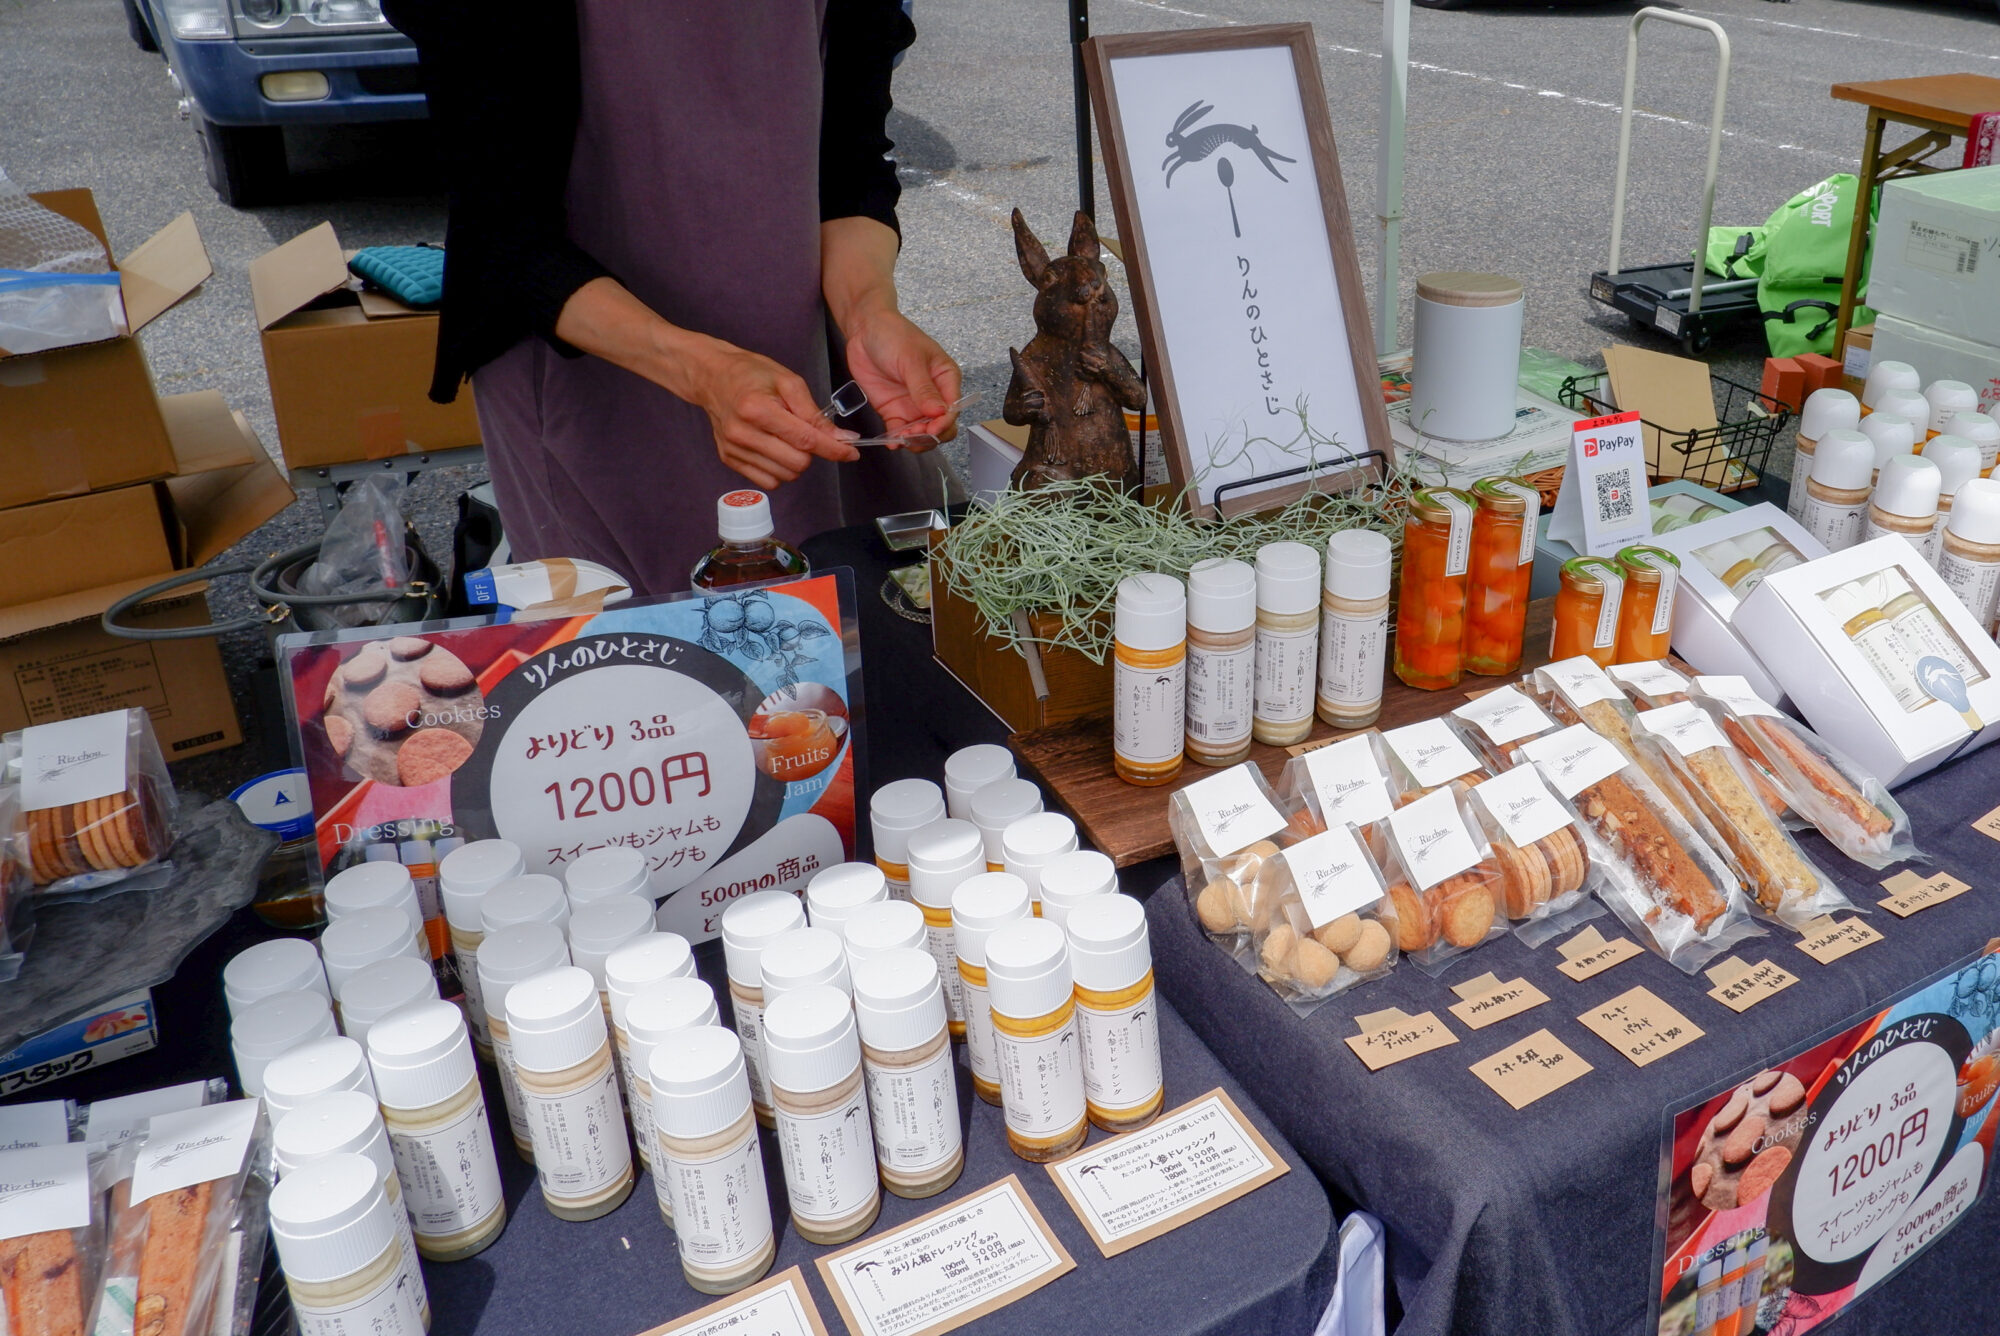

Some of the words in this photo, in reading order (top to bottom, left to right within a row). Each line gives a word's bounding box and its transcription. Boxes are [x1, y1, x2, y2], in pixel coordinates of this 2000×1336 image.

[1236, 255, 1281, 415] りんのひとさじ
[1599, 435, 1635, 453] PayPay
[475, 584, 490, 602] OFF
[522, 637, 685, 689] りんのひとさじ
[405, 703, 502, 730] Cookies
[526, 727, 615, 760] よりどり
[630, 713, 675, 742] 3品
[770, 744, 831, 775] Fruits
[544, 751, 712, 822] 1200円
[783, 774, 824, 801] Jam
[333, 815, 455, 847] Dressing
[547, 814, 721, 866] スイーツもジャムも
[700, 854, 820, 908] 500円の商品
[1107, 1030, 1122, 1095] 人参ドレッシング
[1537, 1053, 1563, 1069] ¥300
[1837, 1018, 1938, 1087] りんのひとさじ
[932, 1078, 948, 1153] みりん粕ドレッシング
[1037, 1056, 1053, 1123] 人参ドレッシング
[1961, 1081, 1998, 1114] Fruits
[585, 1105, 607, 1177] みりん粕ドレッシング
[1751, 1111, 1818, 1156] Cookies
[1824, 1104, 1881, 1153] よりどり
[1890, 1082, 1917, 1113] 3品
[1962, 1108, 1989, 1134] Jam
[818, 1133, 839, 1209] みりん粕ドレッシング
[1149, 1131, 1217, 1168] 人参ドレッシング
[1160, 1161, 1182, 1175] 100ml
[1165, 1168, 1188, 1181] 180ml
[1828, 1107, 1929, 1198] 1200円
[456, 1141, 481, 1216] みりん粕ドレッシング
[1817, 1163, 1924, 1238] スイーツもジャムも
[723, 1174, 745, 1251] みりん粕ドレッシング
[883, 1208, 984, 1257] 米と米麹の自然の優しさ
[1829, 1191, 1910, 1252] ドレッシングも
[1896, 1178, 1969, 1243] 500円の商品
[891, 1230, 978, 1277] みりん粕ドレッシング
[941, 1258, 965, 1273] 100ml
[944, 1266, 970, 1280] 180ml
[1677, 1225, 1767, 1277] Dressing
